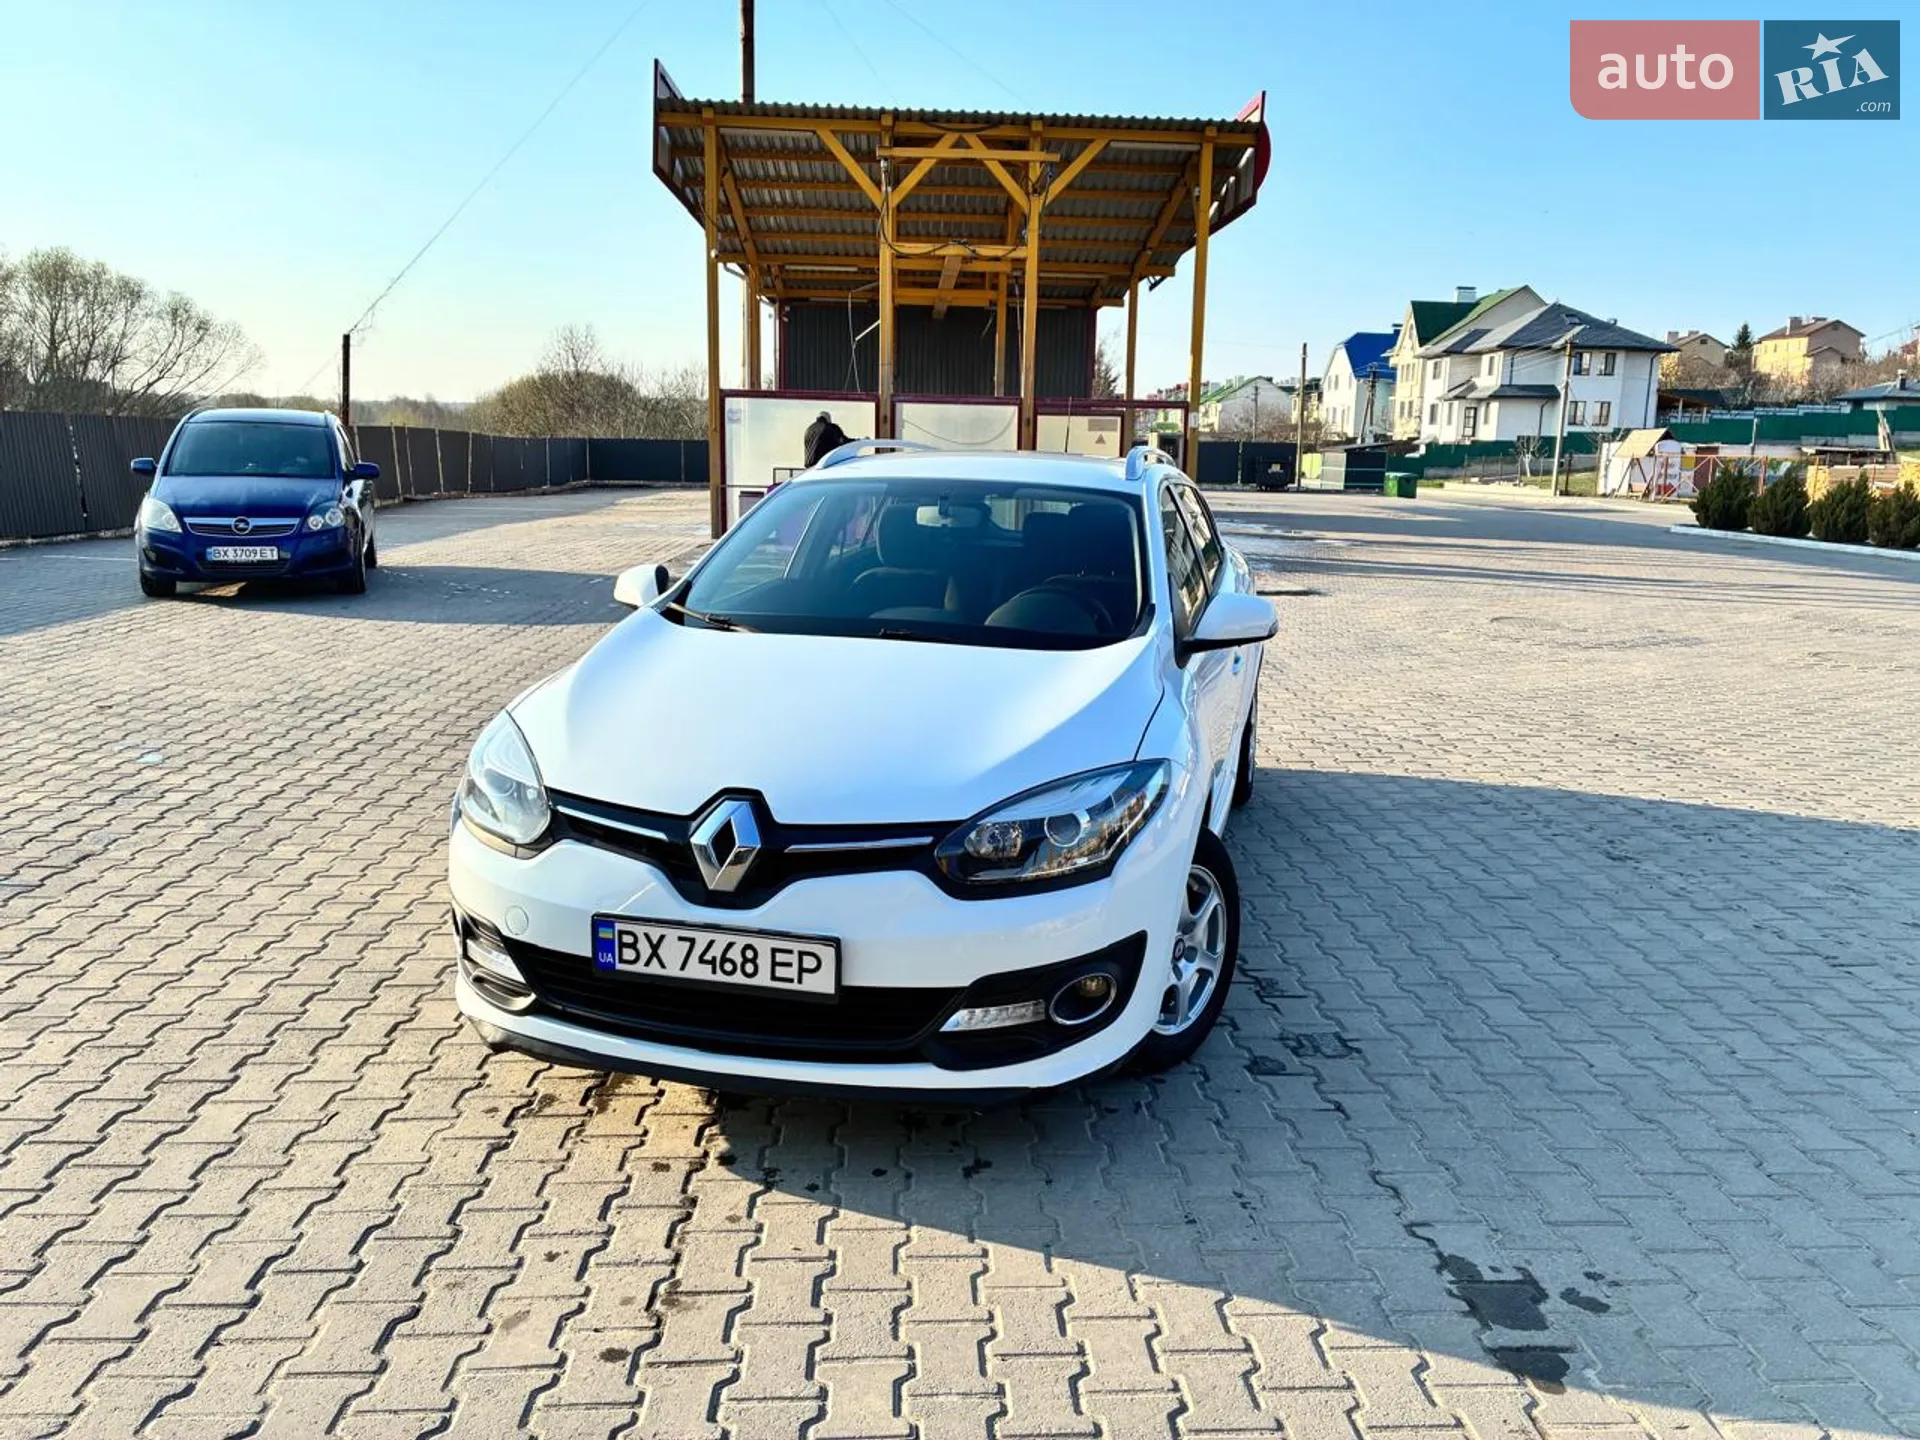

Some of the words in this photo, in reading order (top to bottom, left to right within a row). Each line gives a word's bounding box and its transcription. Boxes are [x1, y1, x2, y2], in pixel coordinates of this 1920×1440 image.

[213, 548, 229, 559] BX
[232, 548, 258, 559] 3709
[598, 952, 614, 964] UA
[617, 929, 667, 970] BX
[677, 936, 759, 978] 7468
[770, 946, 822, 985] EP
